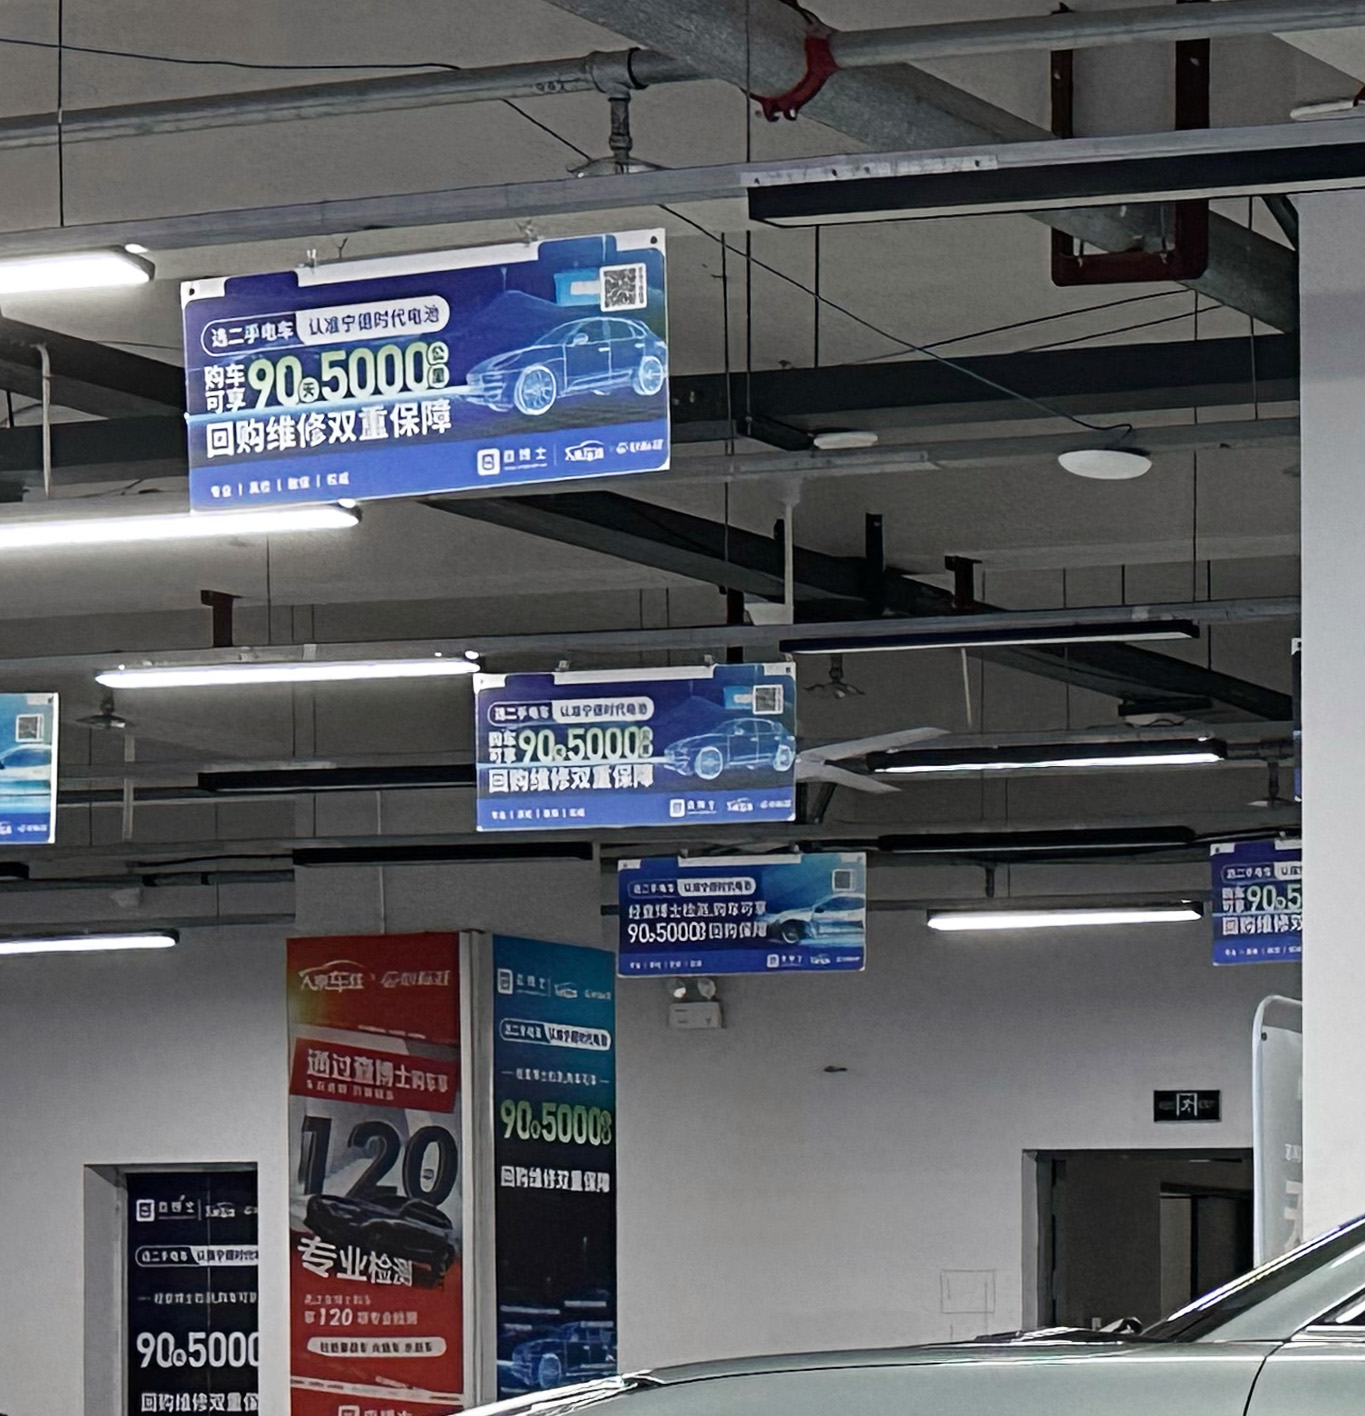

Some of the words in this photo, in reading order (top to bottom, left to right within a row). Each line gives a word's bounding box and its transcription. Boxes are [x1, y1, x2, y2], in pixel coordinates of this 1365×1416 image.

[210, 320, 295, 348] 选二手电车
[205, 399, 452, 459] 回购维修双重保障
[298, 1114, 459, 1208] 120
[297, 1235, 413, 1287] 专业检测
